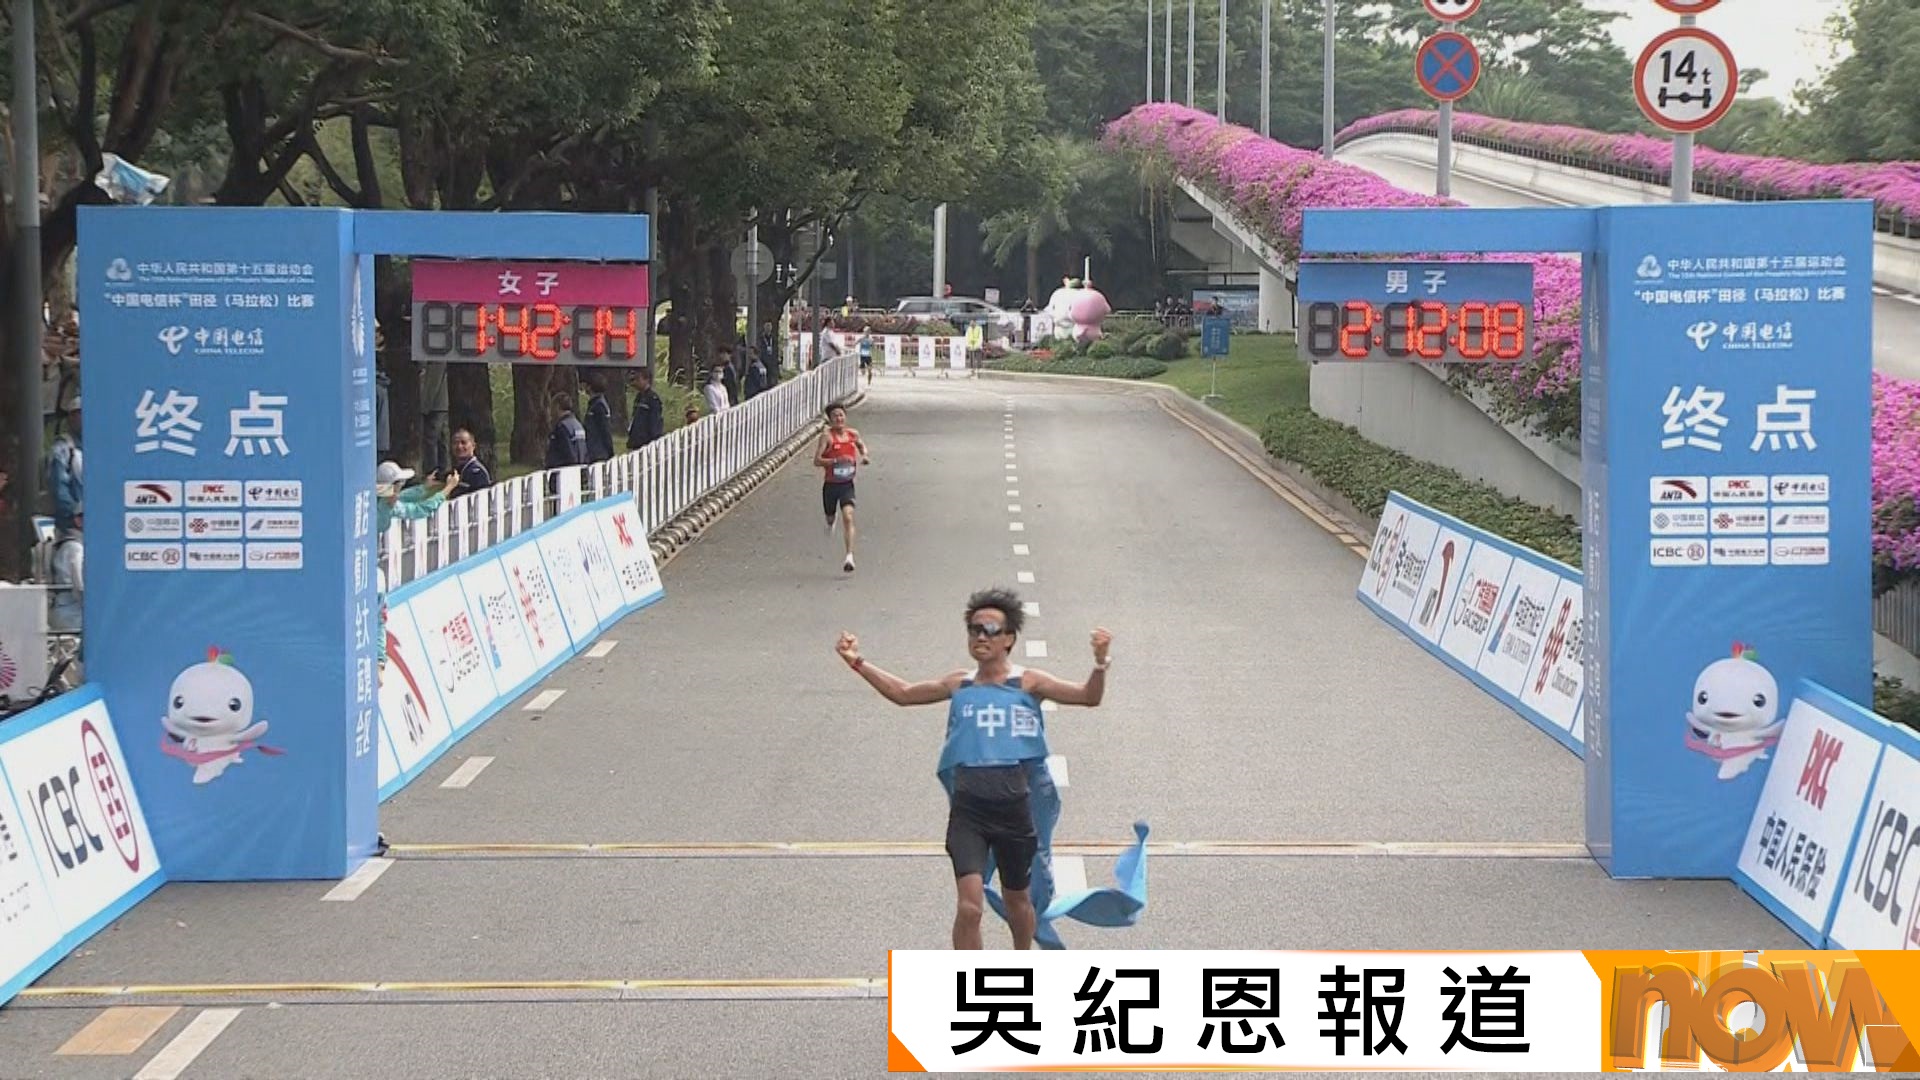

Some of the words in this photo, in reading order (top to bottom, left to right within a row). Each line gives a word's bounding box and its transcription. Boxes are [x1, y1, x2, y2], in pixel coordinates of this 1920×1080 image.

[1668, 256, 1846, 270] 中华人民共和国第十五届运动会
[498, 270, 559, 296] 女子
[1385, 269, 1448, 294] 男子
[194, 327, 264, 348] 中国电信
[476, 302, 637, 361] 1:42:14
[1340, 300, 1526, 360] 2:12:08
[1722, 321, 1793, 342] 中国电信
[135, 389, 289, 457] 终点
[1661, 384, 1818, 452] 终点
[1660, 490, 1683, 501] ANTA
[128, 551, 159, 561] ICBC
[1653, 546, 1683, 557] ICBC
[1796, 728, 1844, 811] PICC
[28, 766, 104, 878] ICBC
[1757, 810, 1829, 901] 中国人民保险
